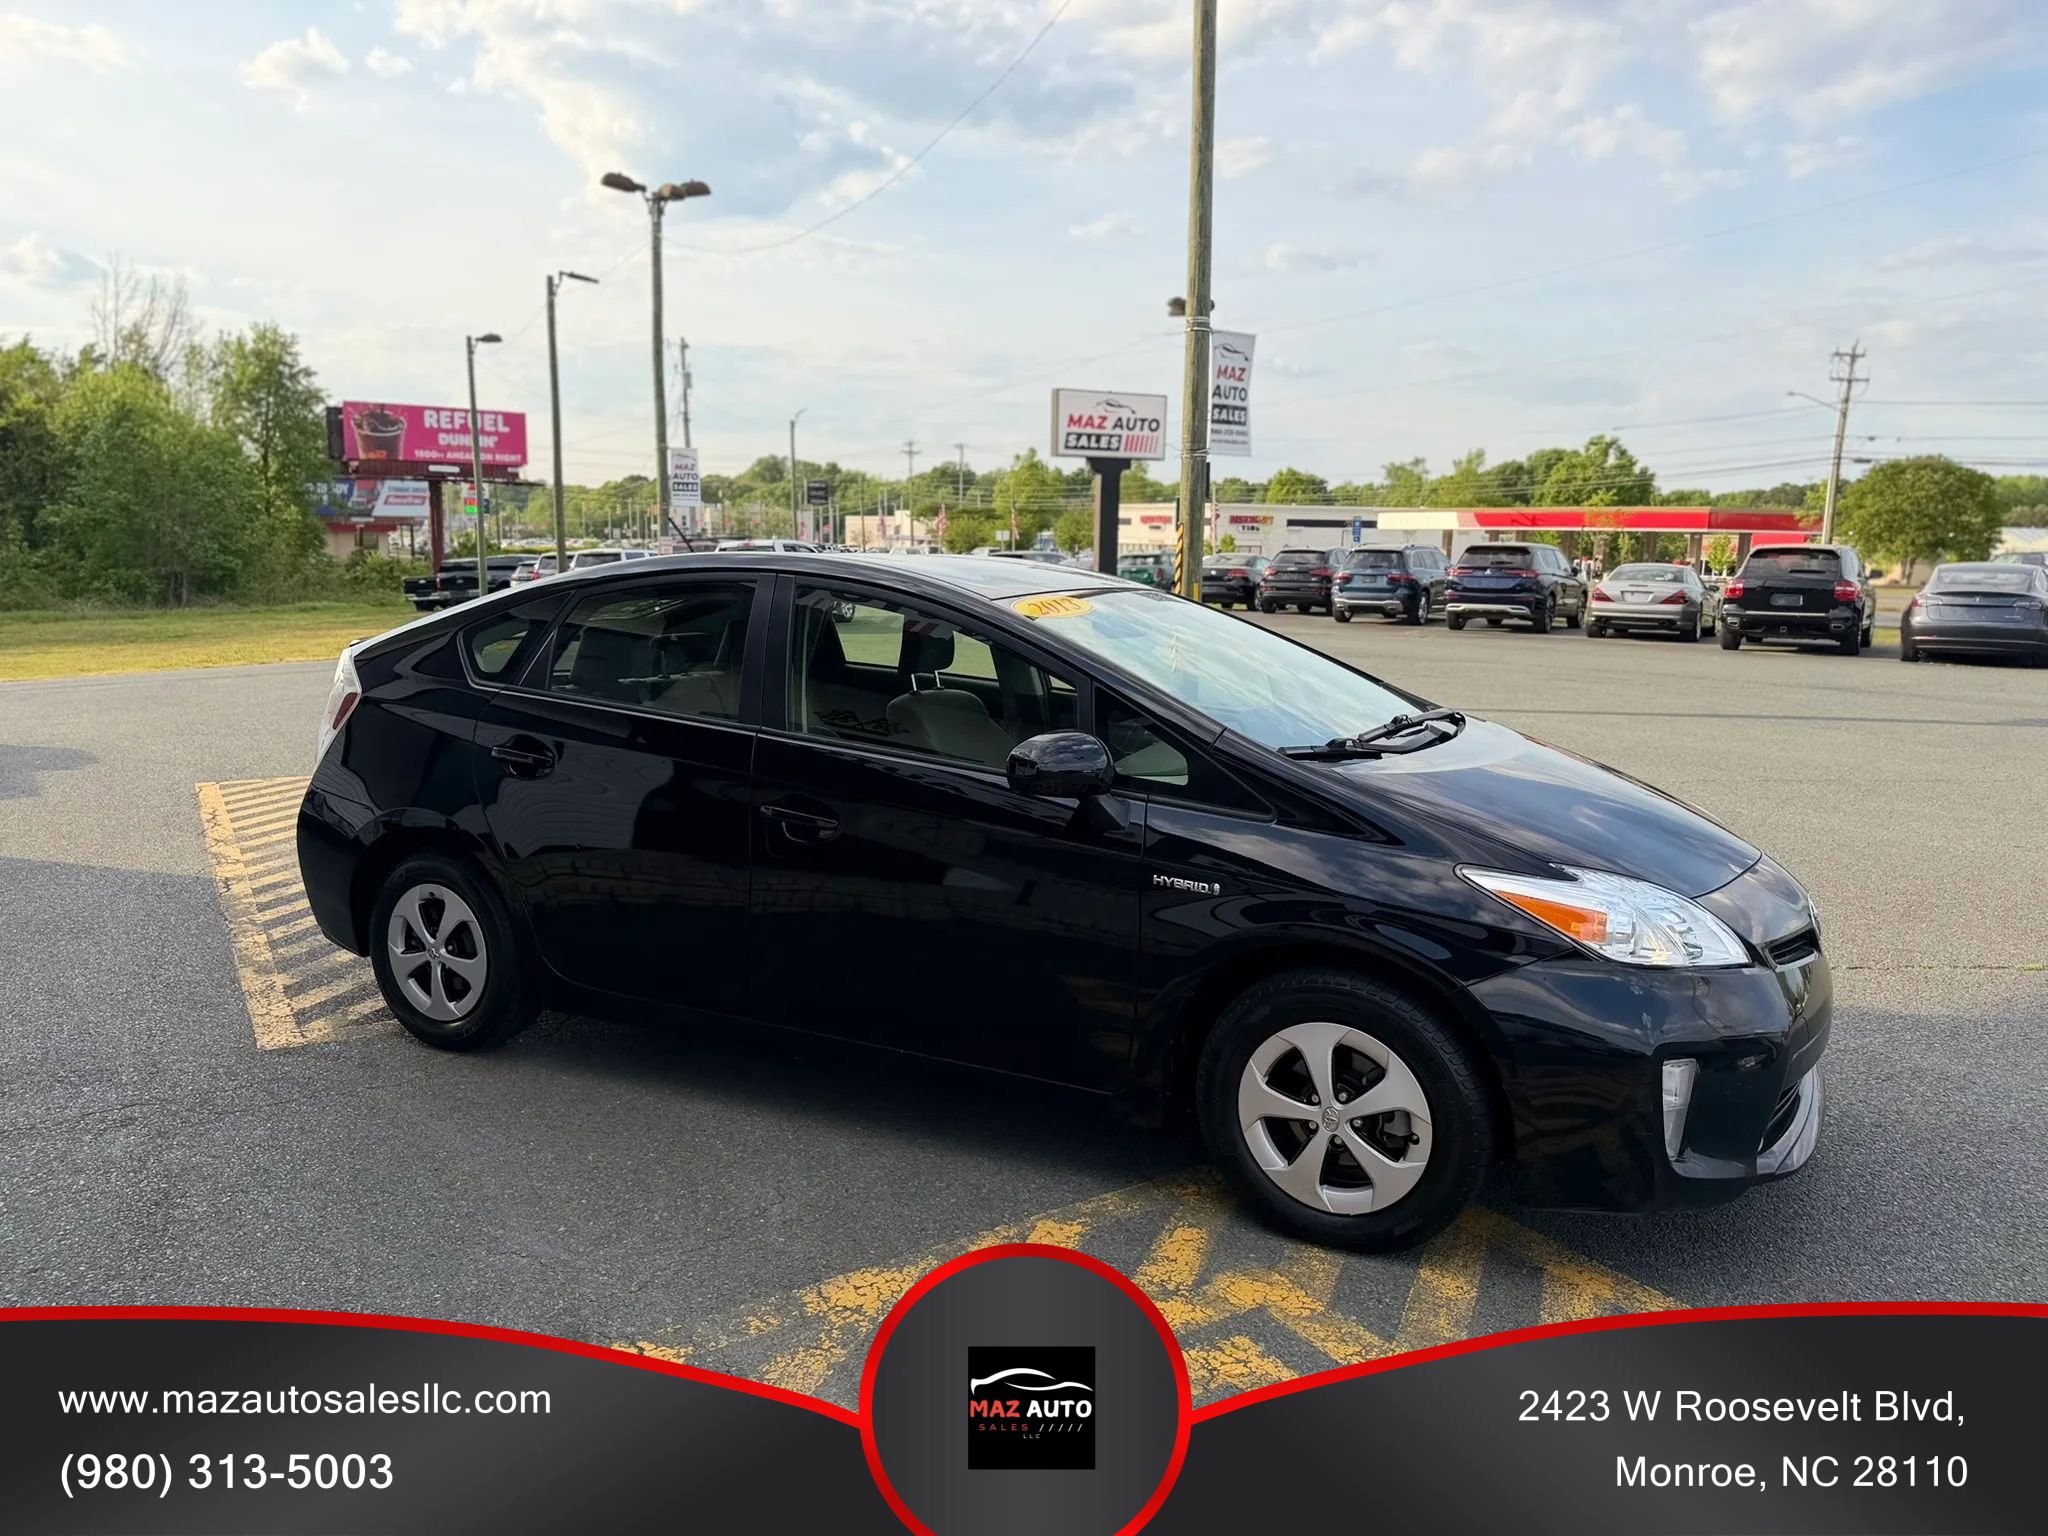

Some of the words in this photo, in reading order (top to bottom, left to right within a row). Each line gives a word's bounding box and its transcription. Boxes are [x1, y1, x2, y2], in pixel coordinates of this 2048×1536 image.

[1217, 365, 1246, 382] MAZ
[1212, 385, 1248, 402] AUTO
[1067, 414, 1108, 430] MAZ
[1112, 417, 1160, 432] AUTO
[1212, 407, 1246, 423] SALES
[1066, 434, 1120, 450] SALES
[674, 463, 696, 471] MAZ
[673, 472, 699, 480] AUTO
[674, 483, 698, 491] SALES
[1028, 598, 1081, 616] 2013
[1153, 874, 1210, 894] HYBRID
